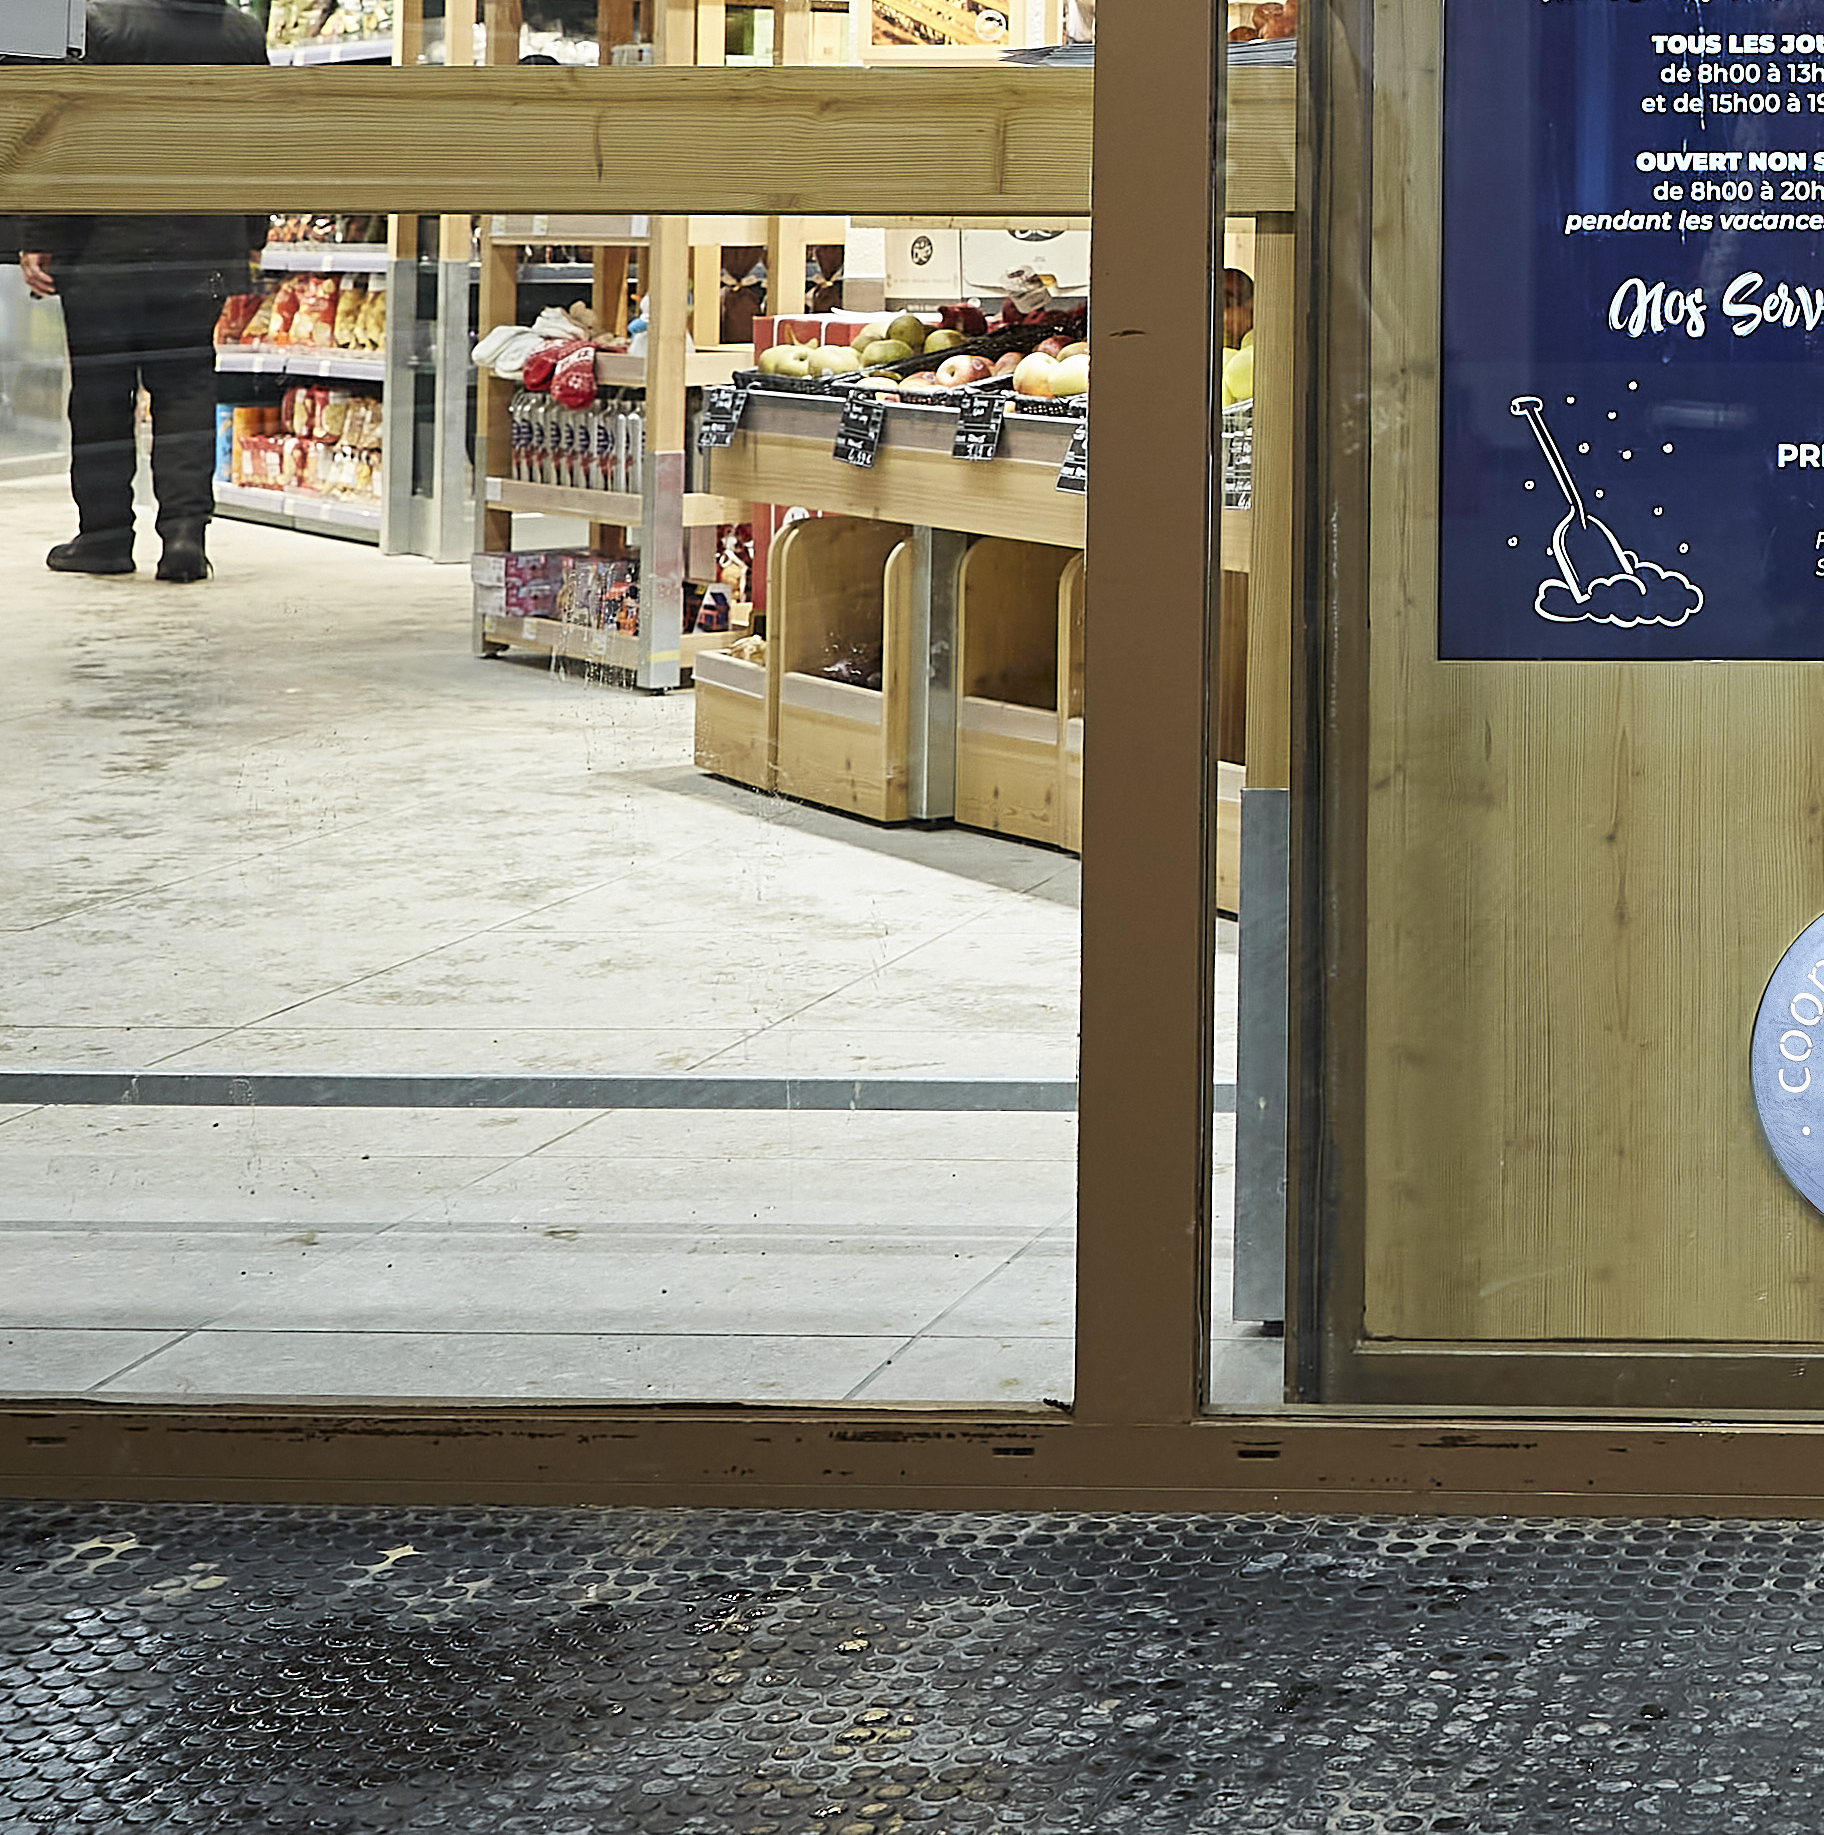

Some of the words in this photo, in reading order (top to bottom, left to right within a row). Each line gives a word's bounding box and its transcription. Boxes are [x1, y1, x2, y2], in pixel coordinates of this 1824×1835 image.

[1651, 34, 1722, 55] TOUS
[1728, 34, 1776, 55] LES
[1660, 64, 1692, 84] de
[1697, 64, 1761, 84] 8h00
[1766, 64, 1782, 84] à
[1641, 93, 1667, 113] et
[1674, 93, 1703, 113] de
[1709, 93, 1781, 113] 15h00
[1786, 93, 1801, 113] à
[1636, 152, 1742, 173] OUVERT
[1748, 152, 1807, 173] NON
[1653, 180, 1684, 202] de
[1690, 180, 1754, 202] 8h00
[1759, 180, 1774, 202] à
[1565, 210, 1672, 235] pendant
[1679, 210, 1713, 232] les
[1608, 278, 1707, 338] Nos
